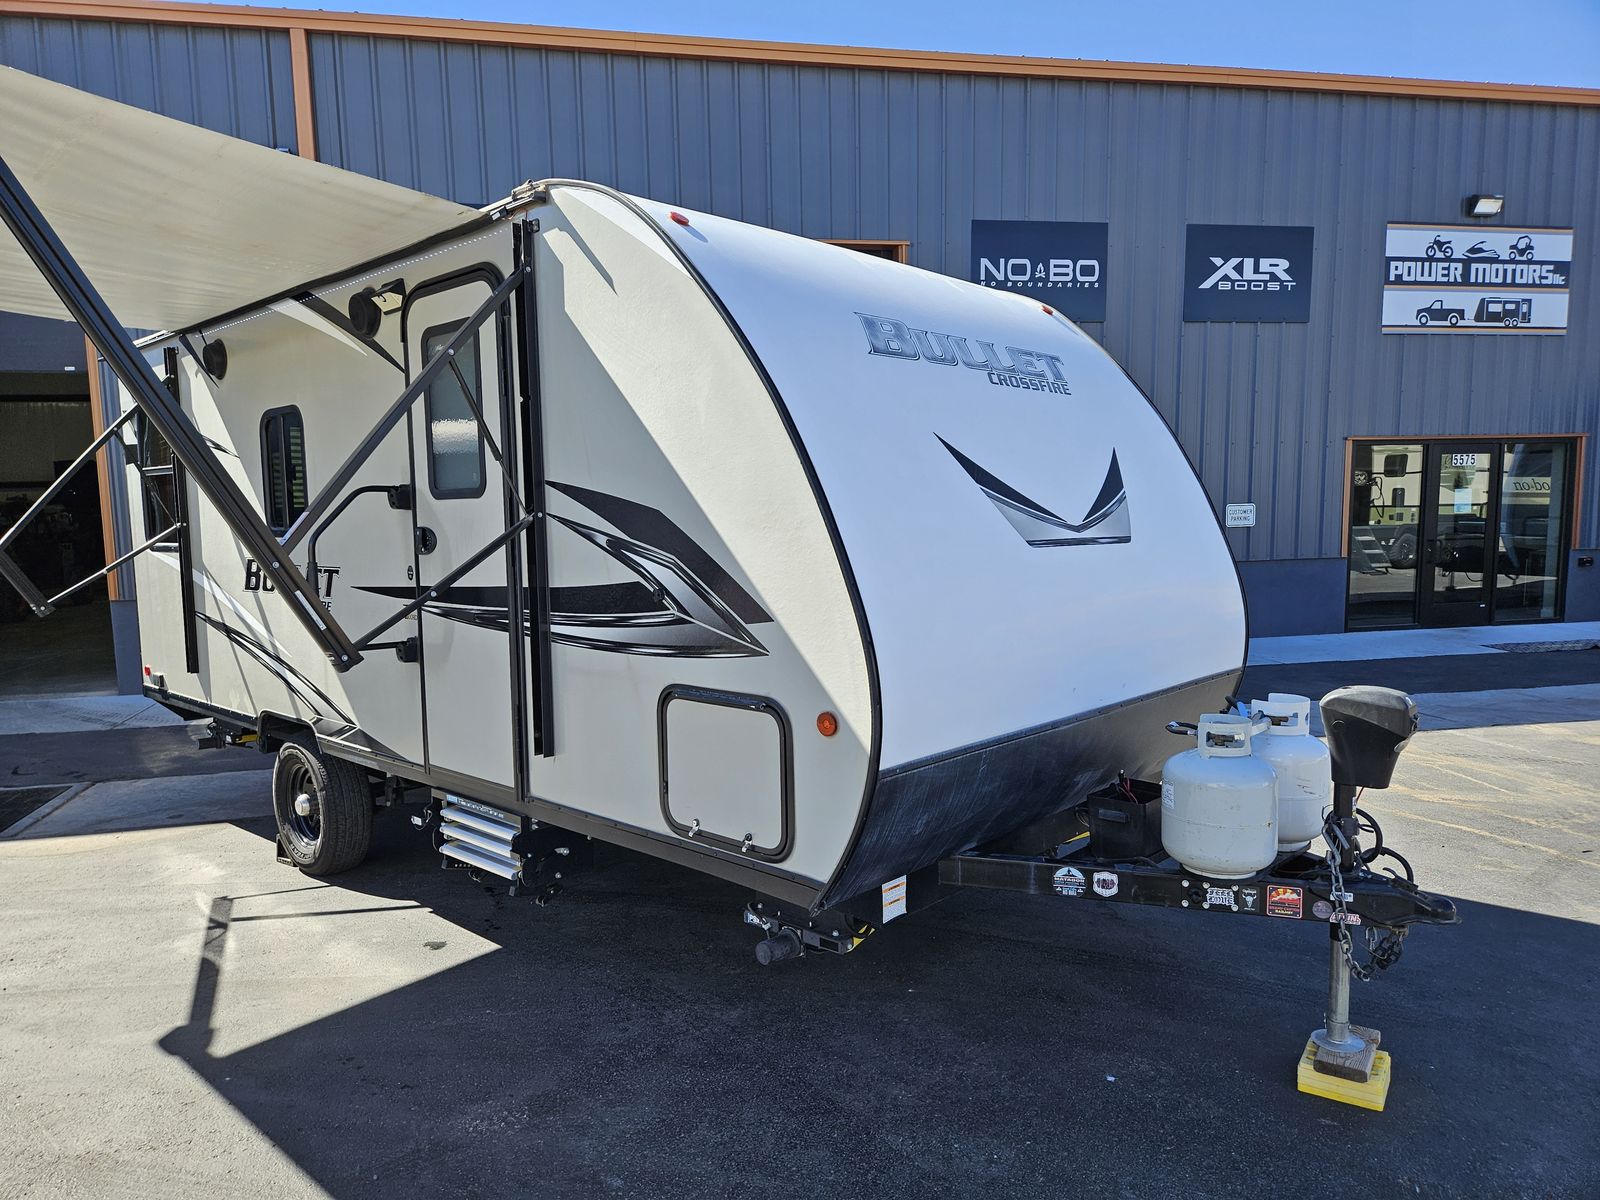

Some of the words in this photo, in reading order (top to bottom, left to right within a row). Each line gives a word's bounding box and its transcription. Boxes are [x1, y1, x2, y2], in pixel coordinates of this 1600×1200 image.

[1199, 257, 1293, 289] XLR
[1389, 261, 1463, 283] POWER
[1470, 263, 1554, 285] MOTORS
[1218, 281, 1296, 291] BOOST
[853, 311, 1068, 383] BULLET
[987, 371, 1072, 396] CROSSFIRE
[1453, 454, 1476, 466] 5575
